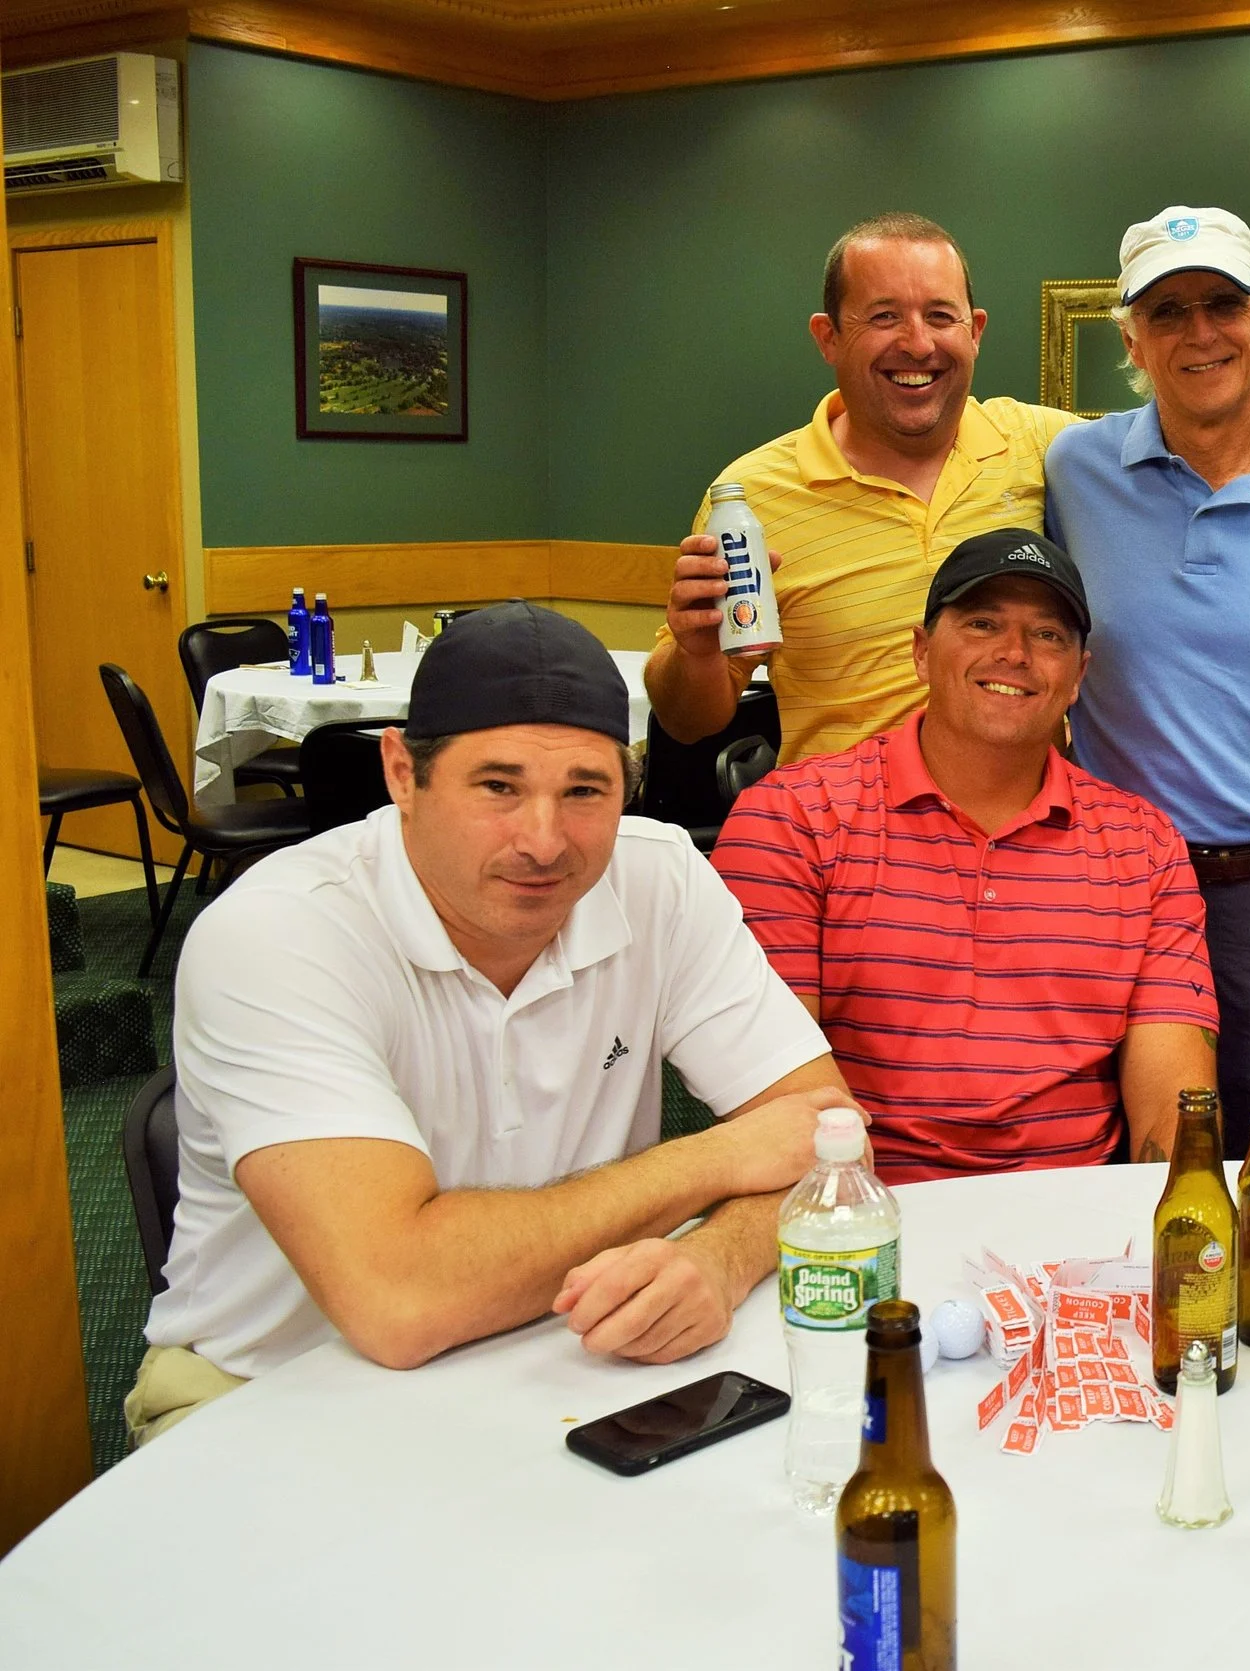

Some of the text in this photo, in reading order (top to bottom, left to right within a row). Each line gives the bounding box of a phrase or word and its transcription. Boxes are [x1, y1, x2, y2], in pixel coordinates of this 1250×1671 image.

[721, 532, 762, 601] Lite
[1008, 552, 1051, 568] adidas
[603, 1046, 629, 1070] adas
[798, 1268, 851, 1286] Poland
[794, 1284, 859, 1311] Spring
[994, 1293, 1018, 1319] TICKET
[1065, 1296, 1104, 1309] COUPON
[1072, 1311, 1096, 1320] KEEP
